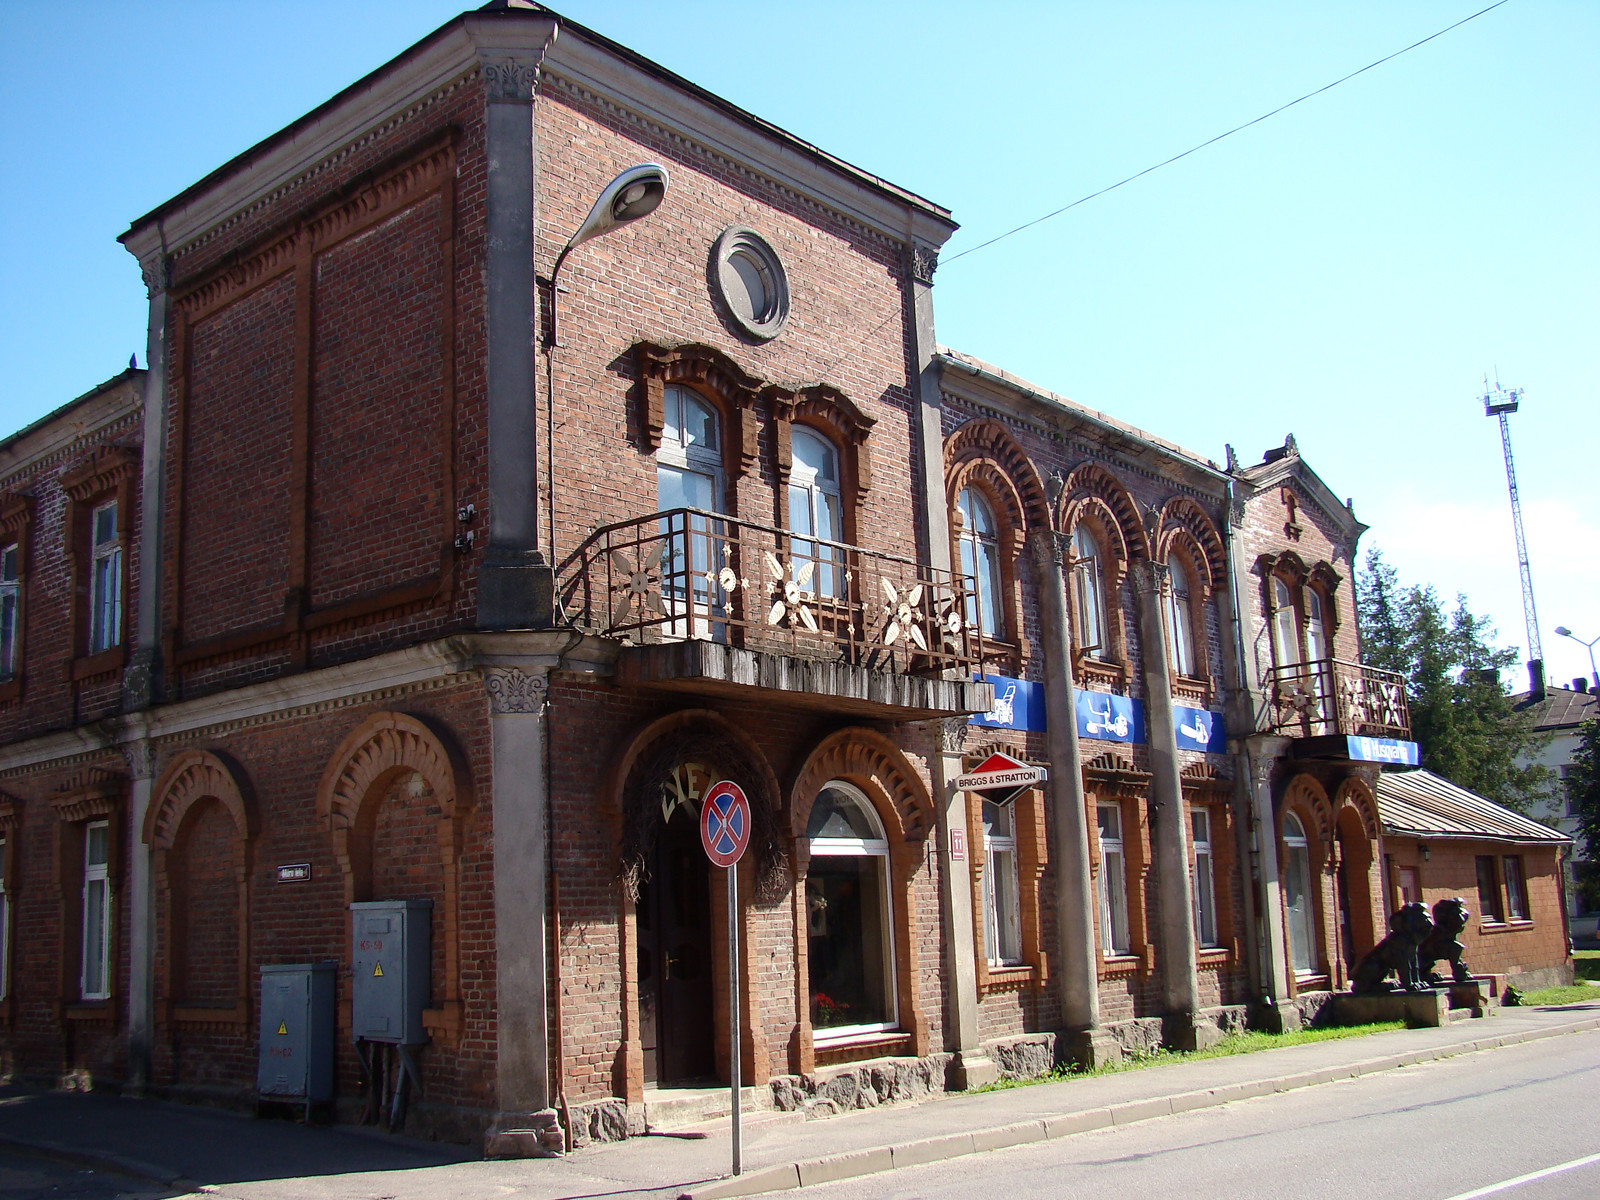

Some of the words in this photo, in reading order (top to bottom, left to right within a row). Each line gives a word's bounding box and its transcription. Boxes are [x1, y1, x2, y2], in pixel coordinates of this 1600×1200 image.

[959, 776, 988, 788] BRIGGS
[989, 776, 995, 785] &
[995, 771, 1036, 784] STRATTON
[954, 838, 962, 850] 11
